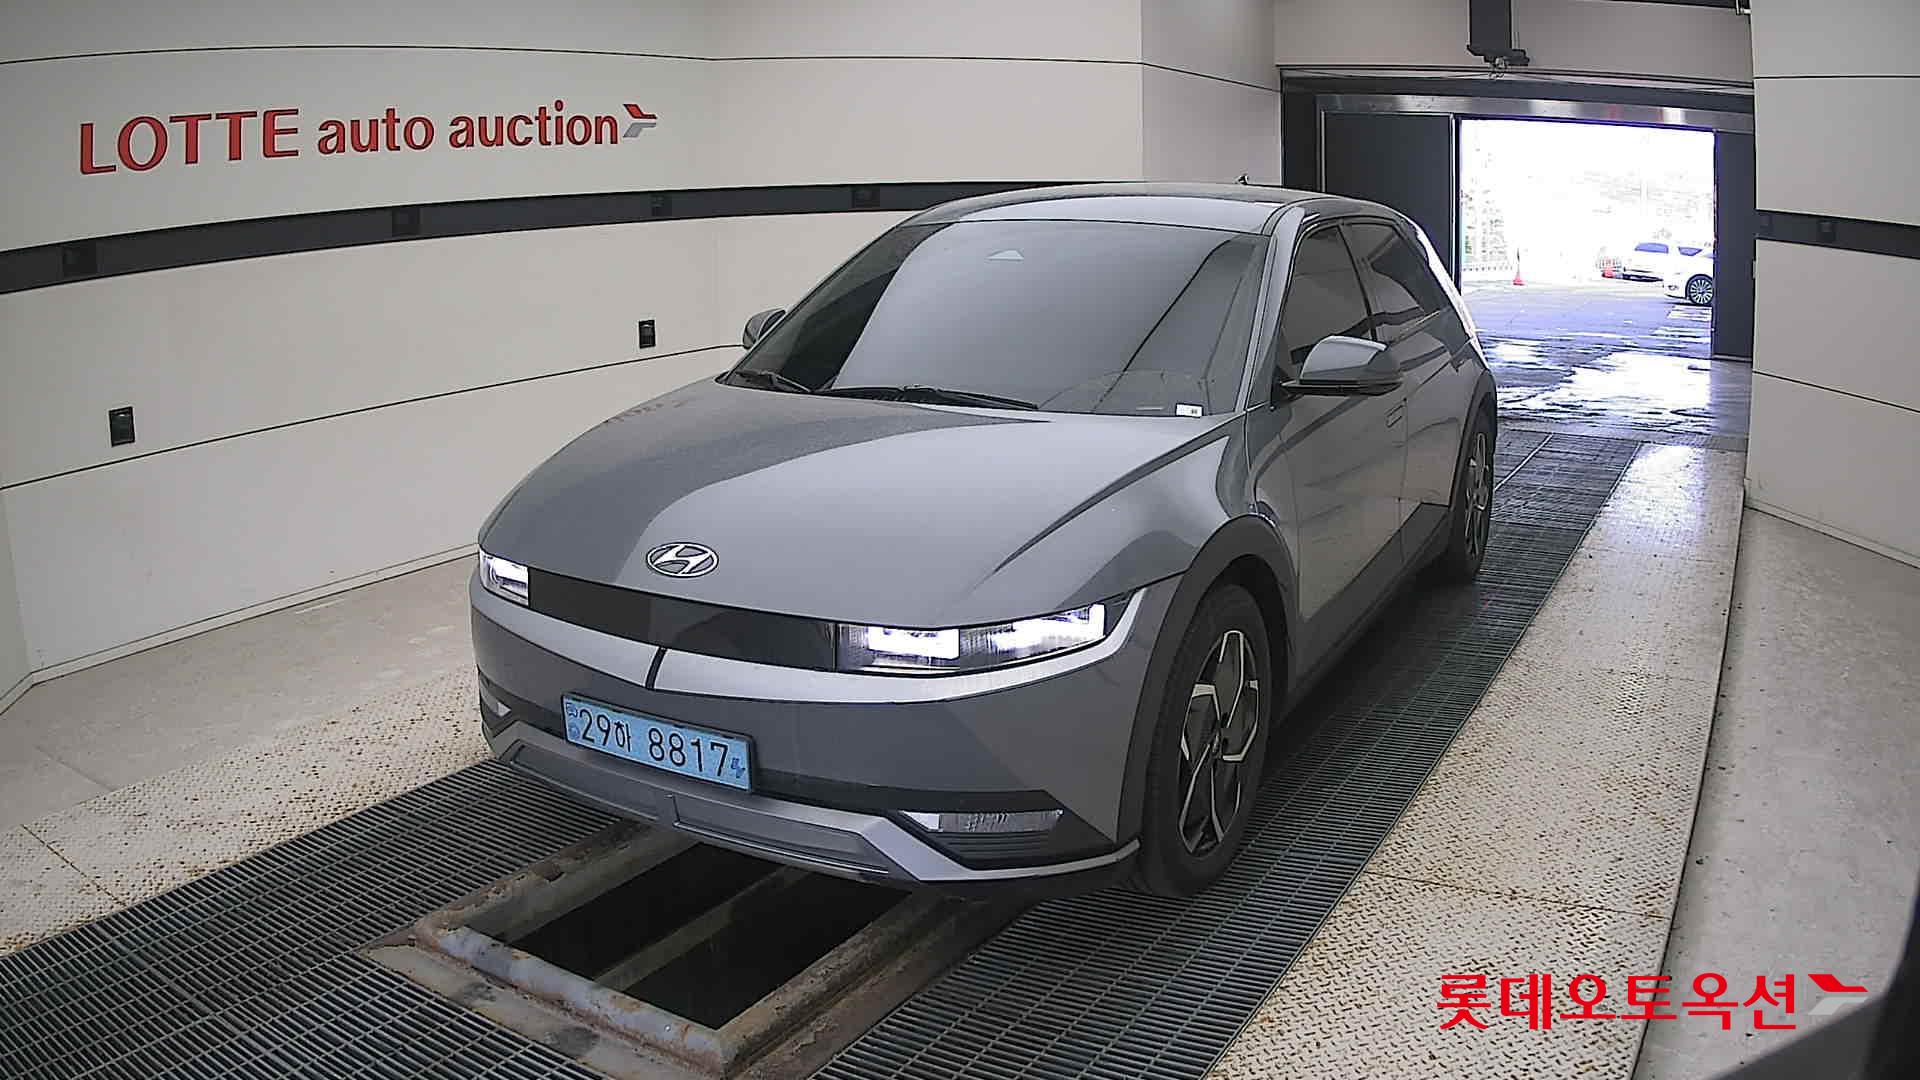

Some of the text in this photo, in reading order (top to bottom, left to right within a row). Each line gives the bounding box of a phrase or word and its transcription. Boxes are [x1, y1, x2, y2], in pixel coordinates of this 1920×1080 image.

[80, 100, 618, 175] LOTTE auto auction
[579, 708, 631, 753] 29하
[648, 727, 729, 777] 8817
